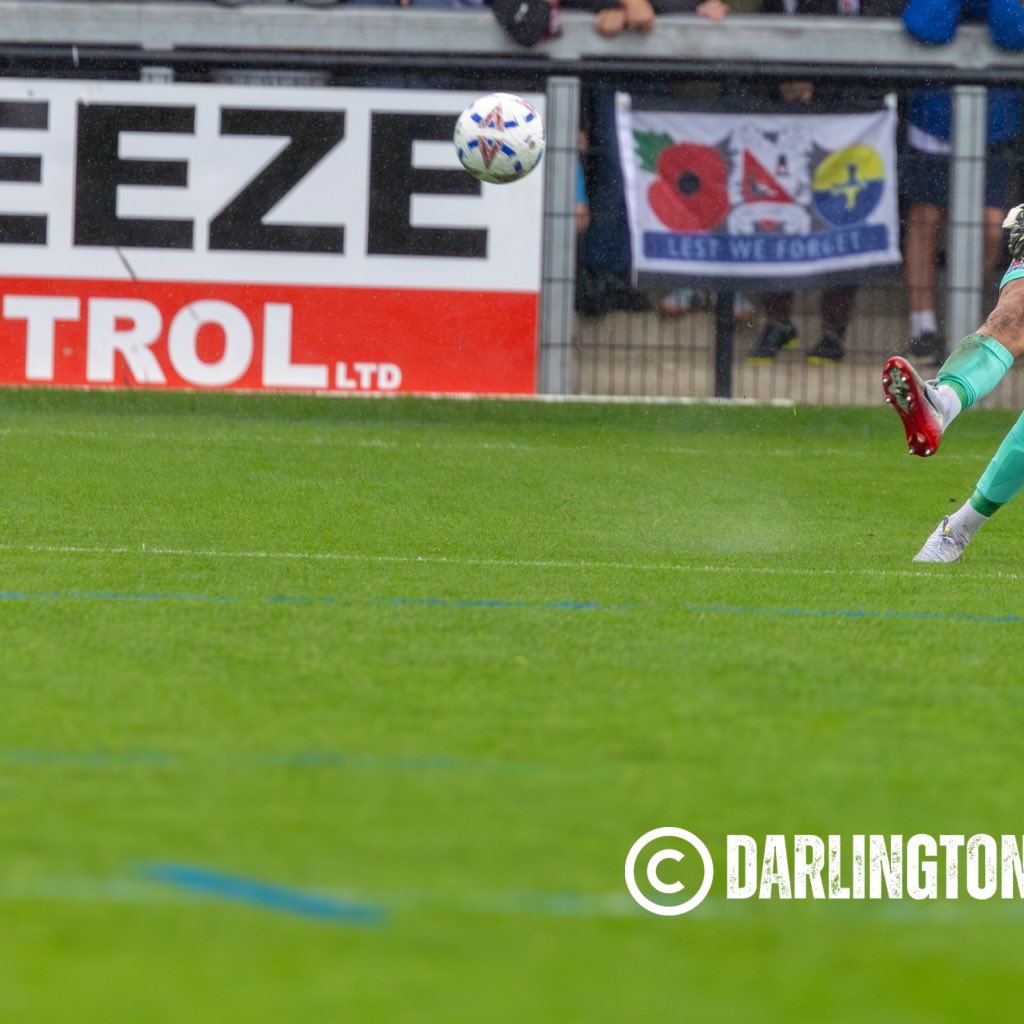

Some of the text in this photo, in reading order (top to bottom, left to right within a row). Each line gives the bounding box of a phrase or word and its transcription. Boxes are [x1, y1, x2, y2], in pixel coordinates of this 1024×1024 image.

[667, 230, 862, 261] LEST WE FORGET
[3, 294, 402, 390] TROL LTD
